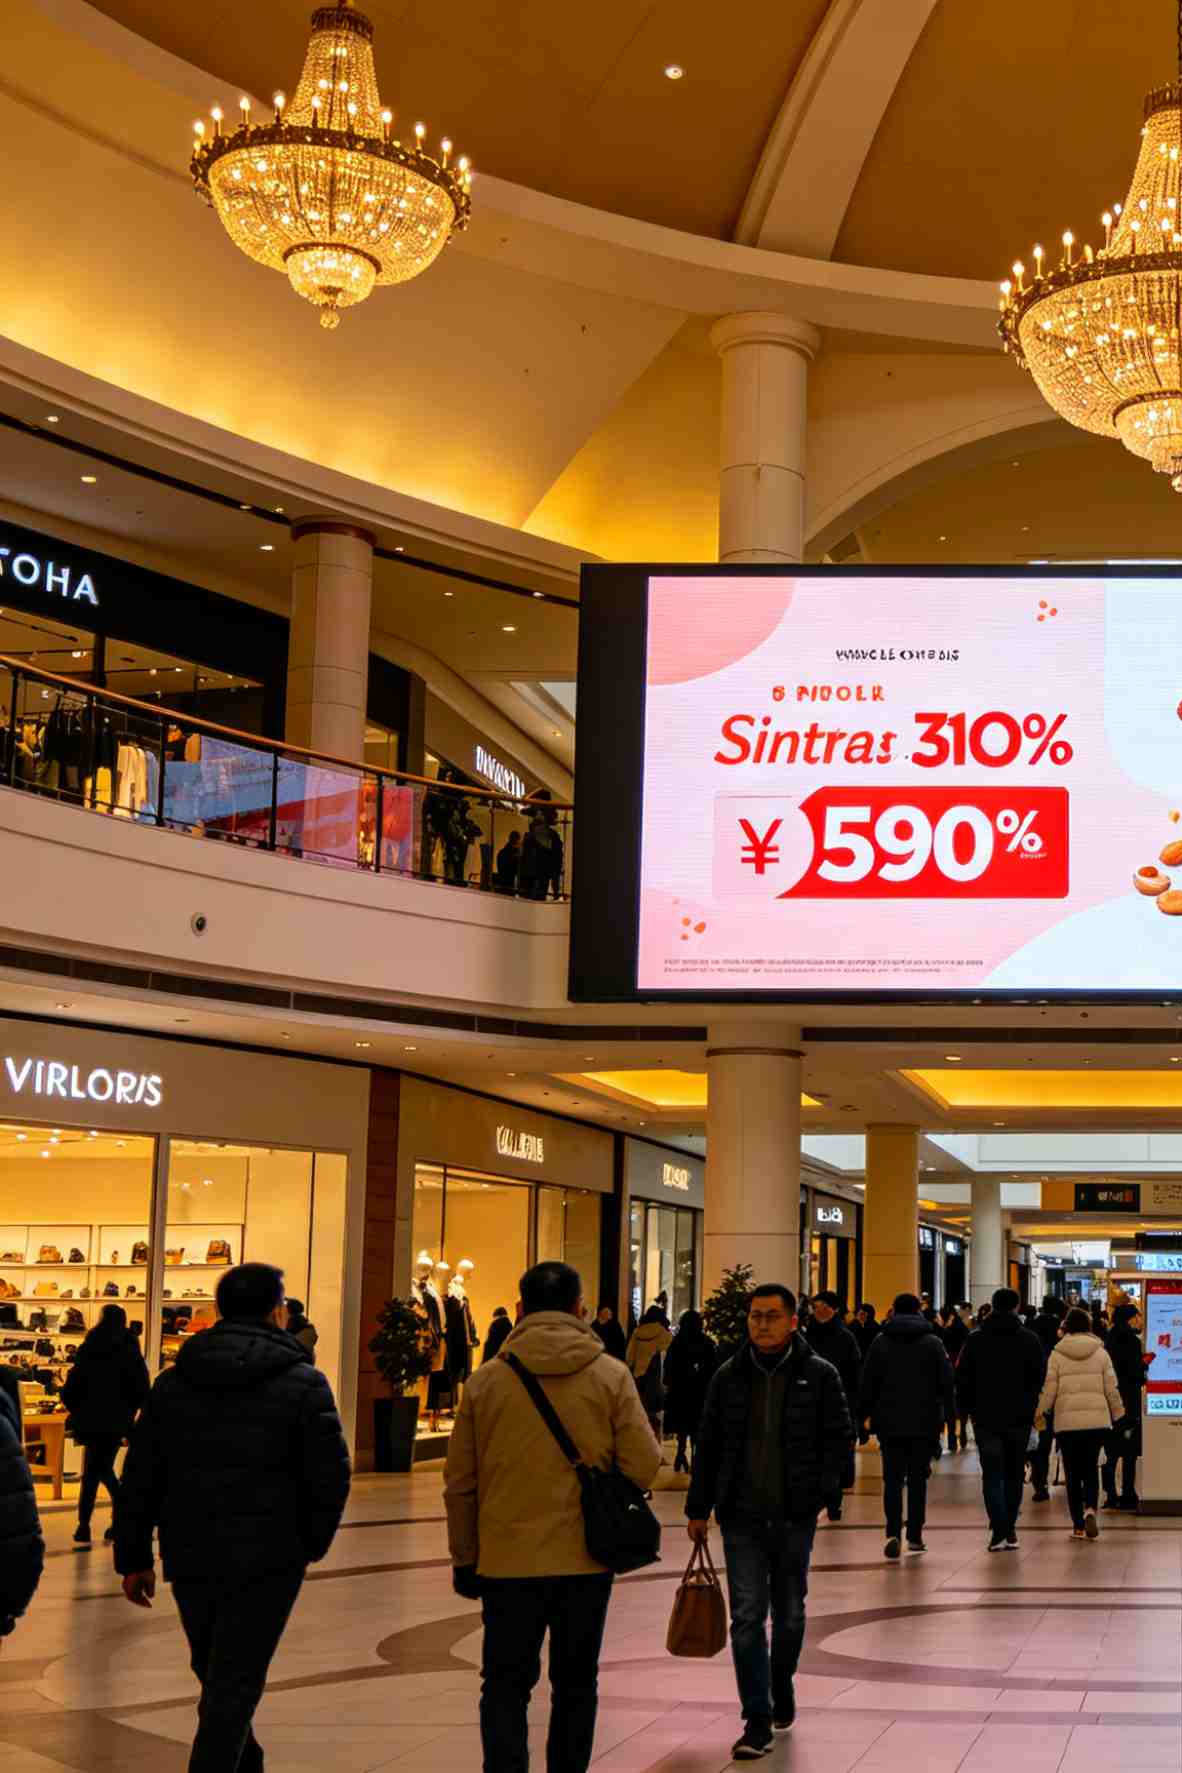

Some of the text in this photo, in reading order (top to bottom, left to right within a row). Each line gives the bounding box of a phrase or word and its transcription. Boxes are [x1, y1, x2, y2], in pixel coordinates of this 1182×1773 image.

[911, 711, 1073, 768] 310%
[738, 804, 1043, 883] ¥ 590%
[5, 1057, 162, 1107] VIRLORIS
